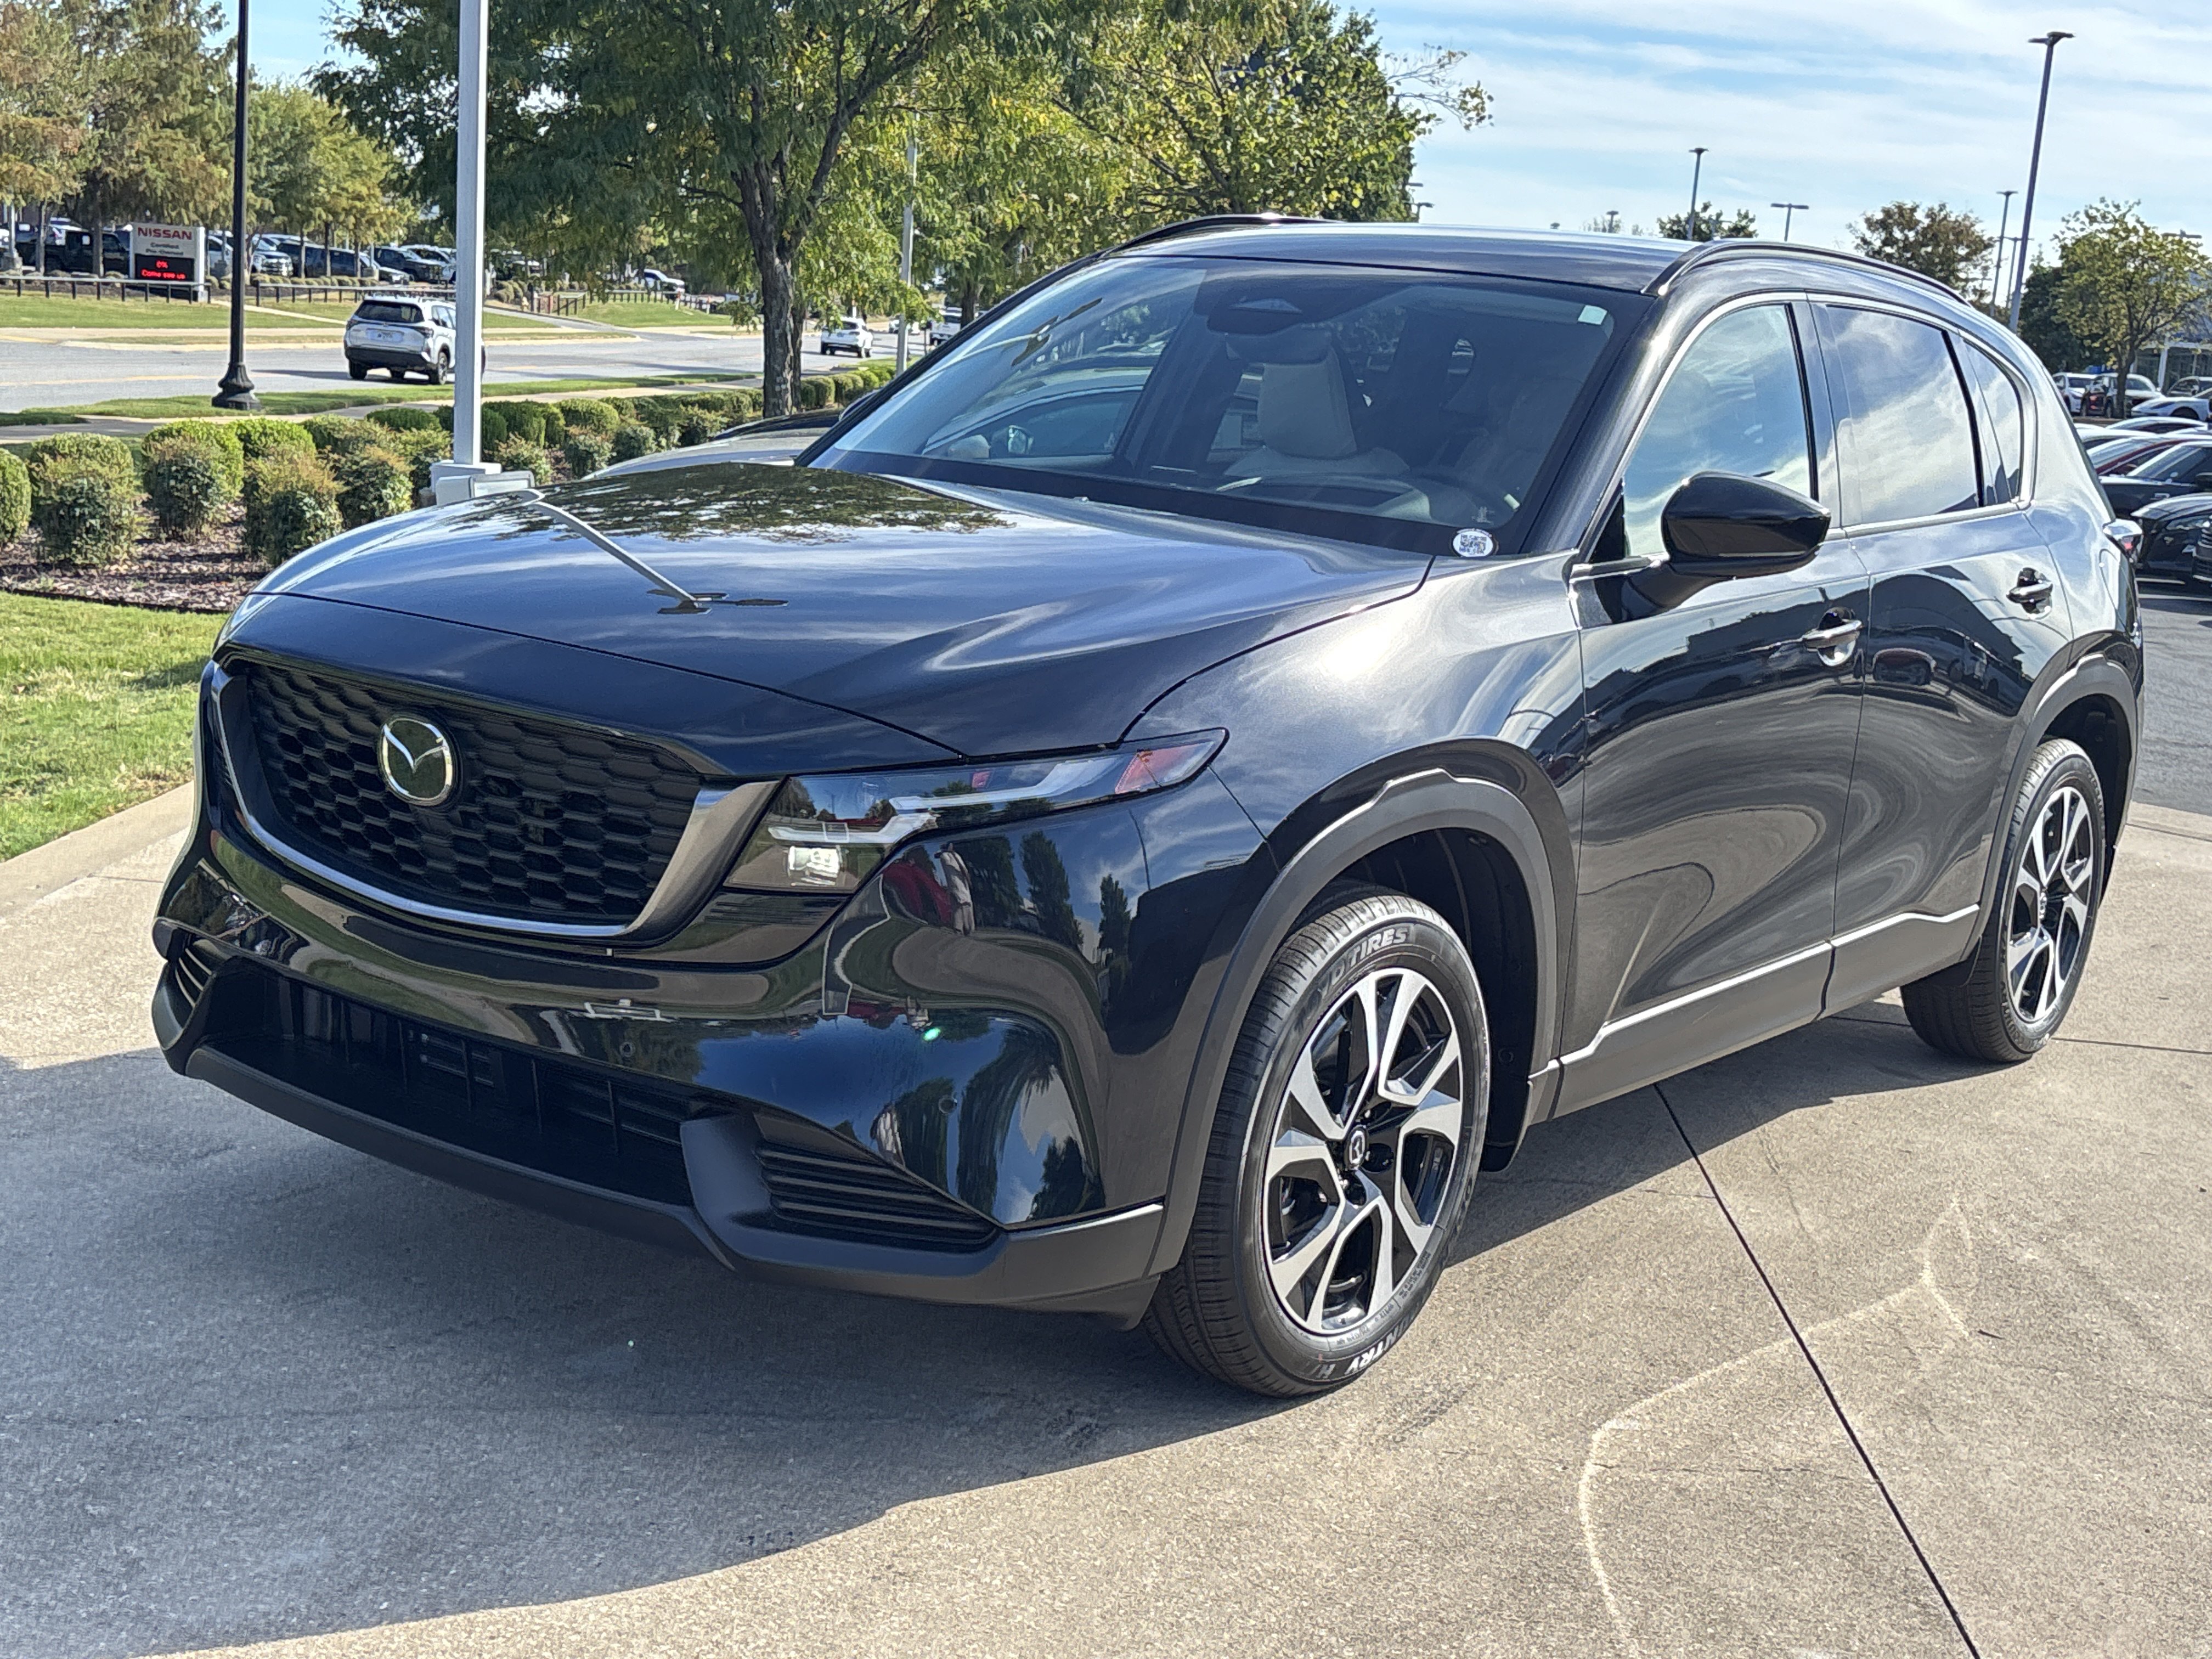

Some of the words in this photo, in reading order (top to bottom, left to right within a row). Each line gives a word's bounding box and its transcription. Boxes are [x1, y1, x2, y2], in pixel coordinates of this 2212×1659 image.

[138, 227, 191, 240] NISSAN
[141, 269, 161, 277] Come
[1348, 927, 1408, 967] TIRES
